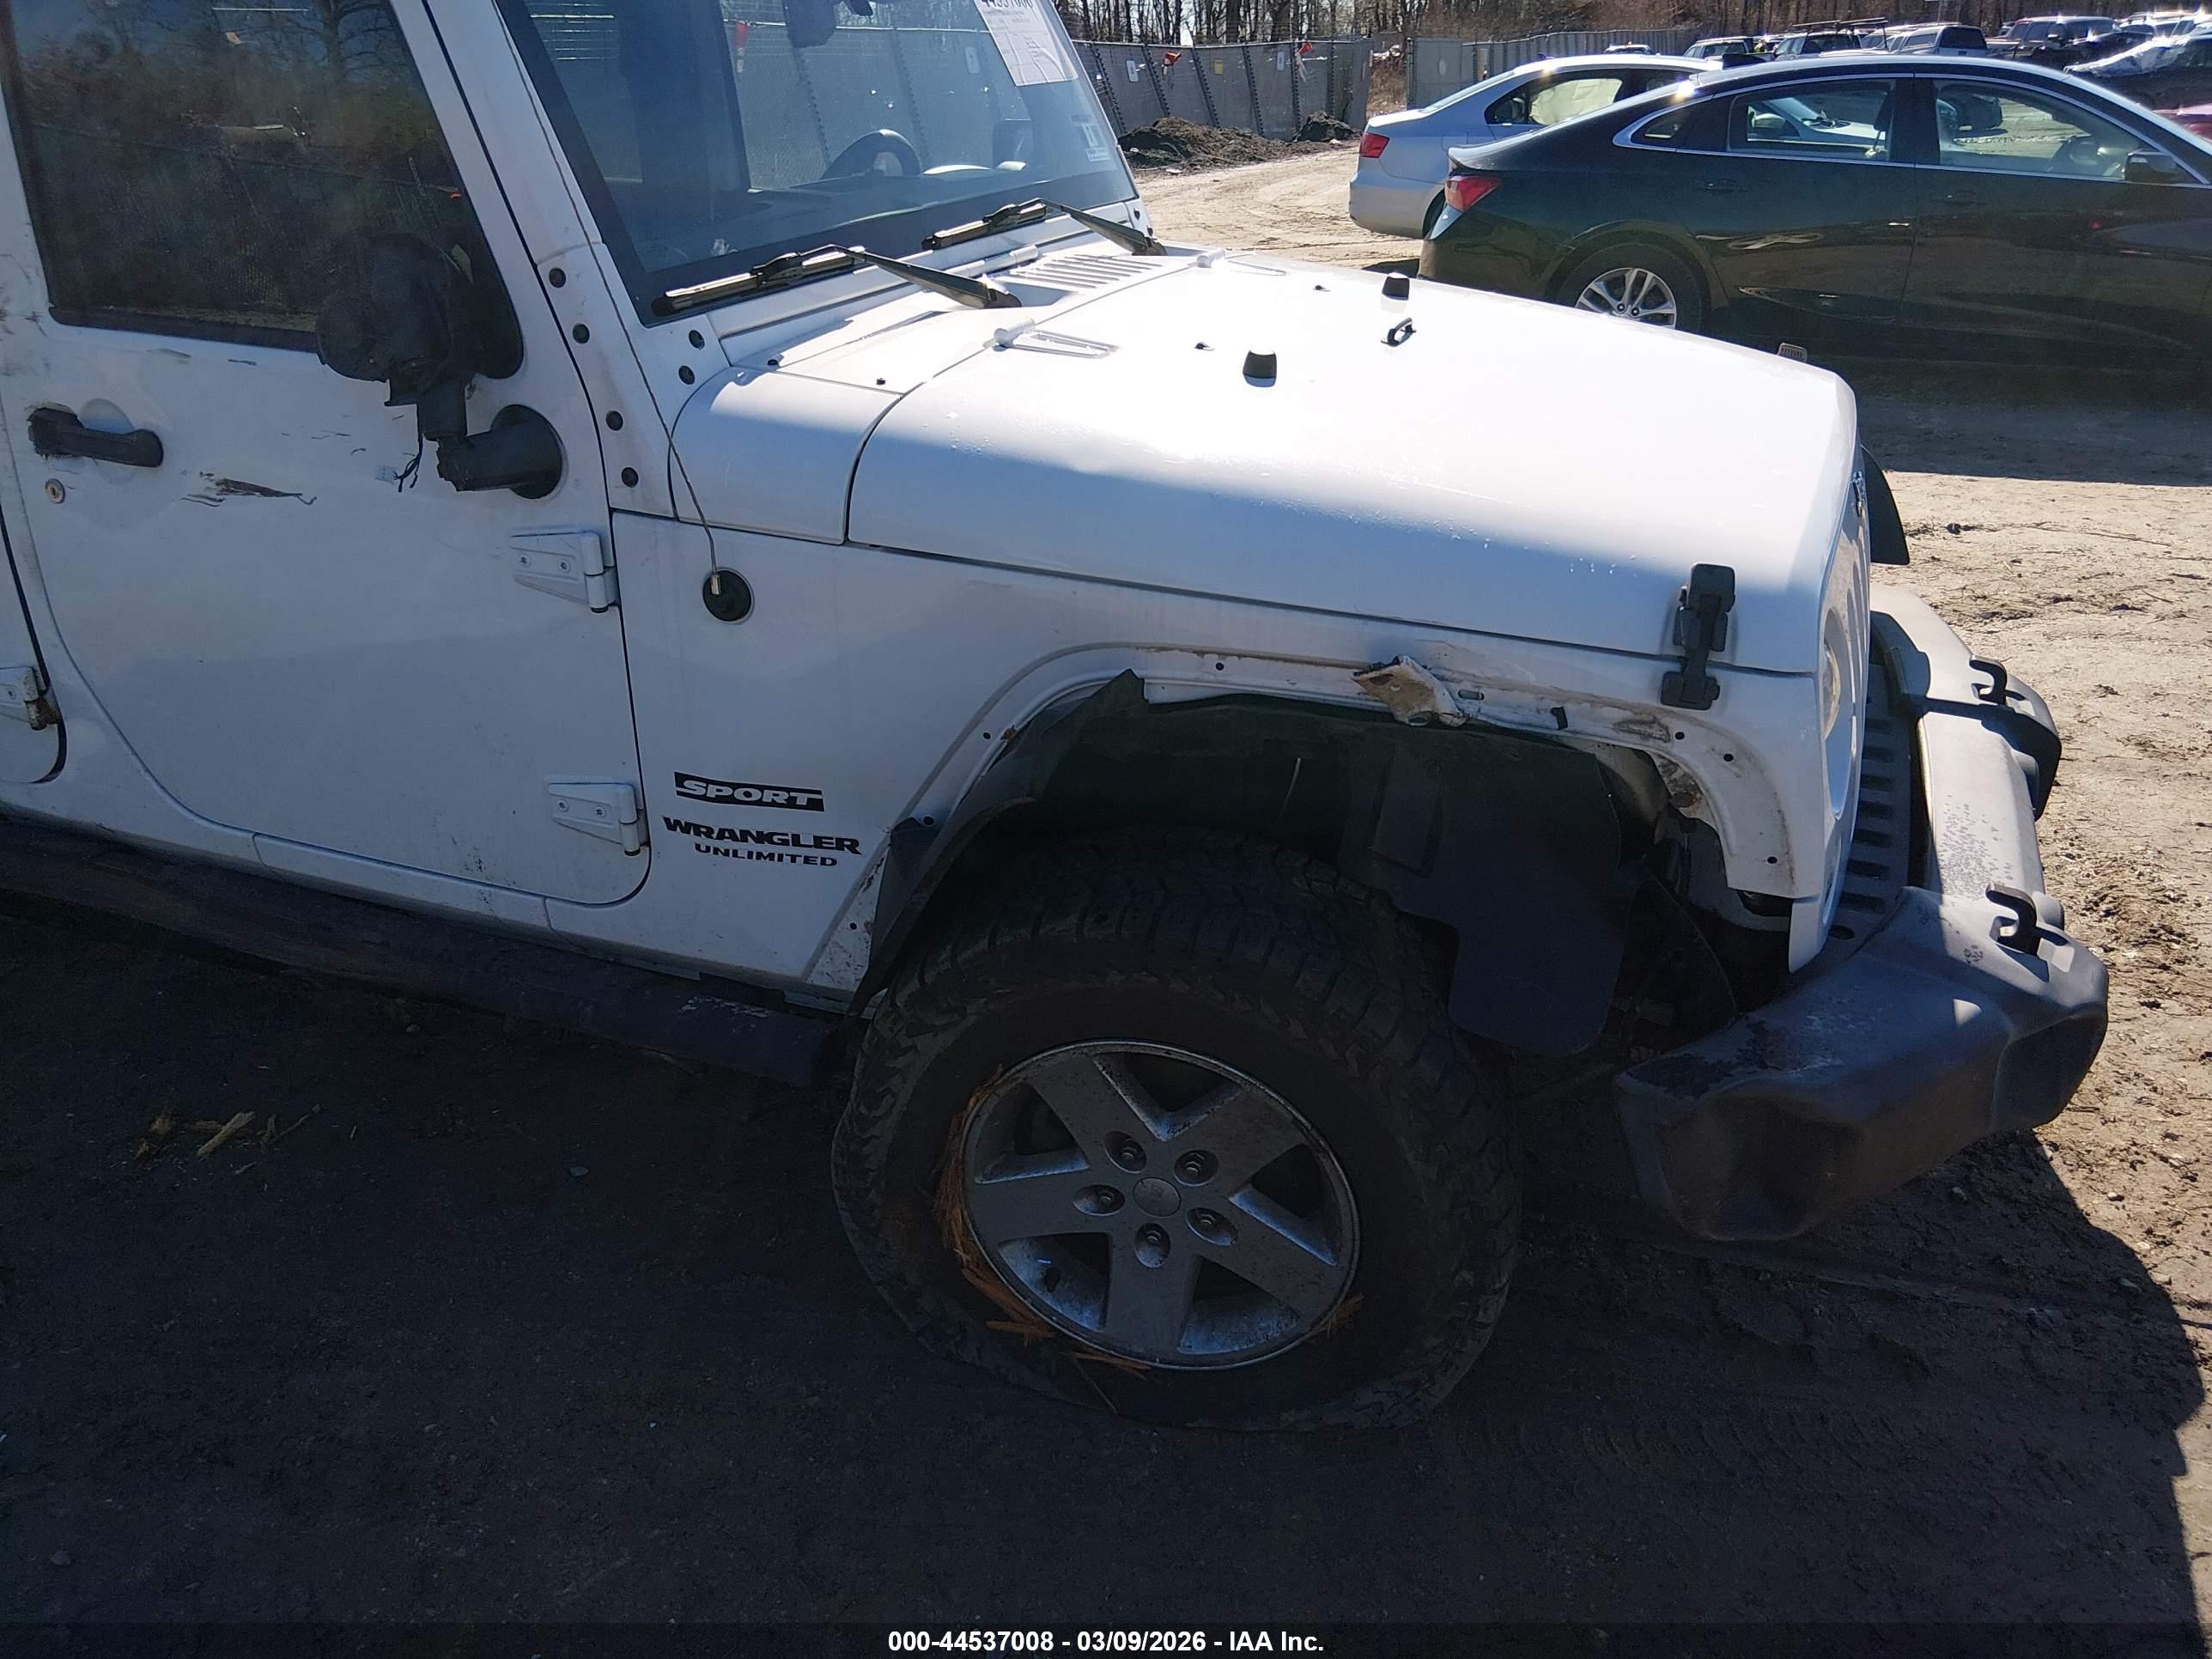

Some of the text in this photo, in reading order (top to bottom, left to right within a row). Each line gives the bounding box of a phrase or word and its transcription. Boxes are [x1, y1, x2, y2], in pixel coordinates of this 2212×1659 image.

[676, 779, 823, 806] SPORT
[663, 817, 861, 854] WRANGLER
[695, 843, 838, 866] UNLIMITED
